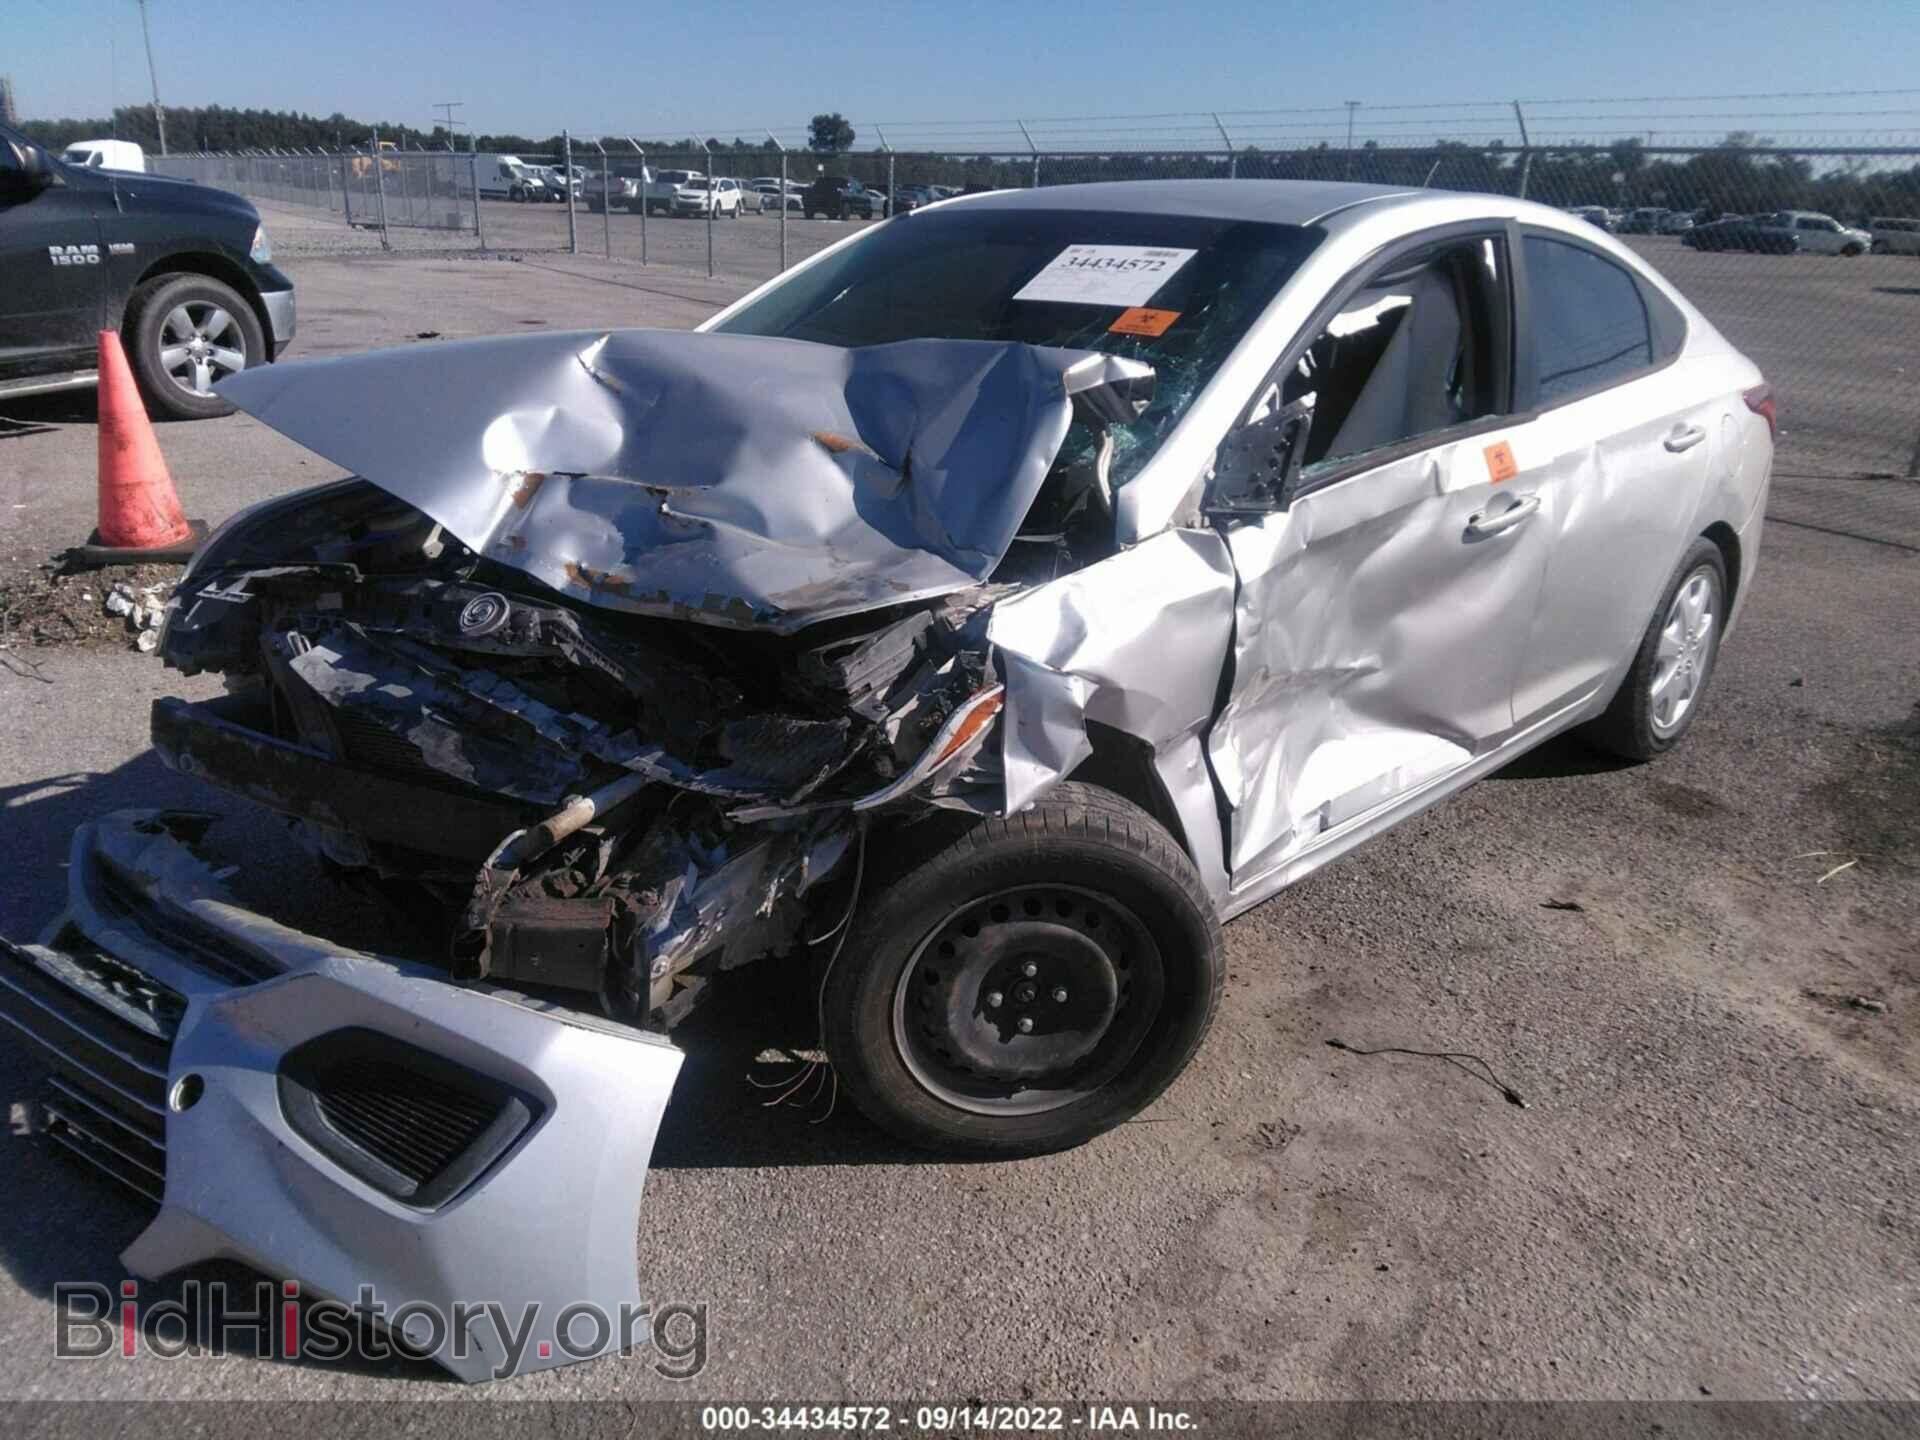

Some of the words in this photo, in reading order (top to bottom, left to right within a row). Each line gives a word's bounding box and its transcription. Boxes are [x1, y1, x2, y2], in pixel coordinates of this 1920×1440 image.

[48, 244, 99, 255] RAM
[50, 254, 100, 265] 1500
[1061, 256, 1166, 272] 34434572
